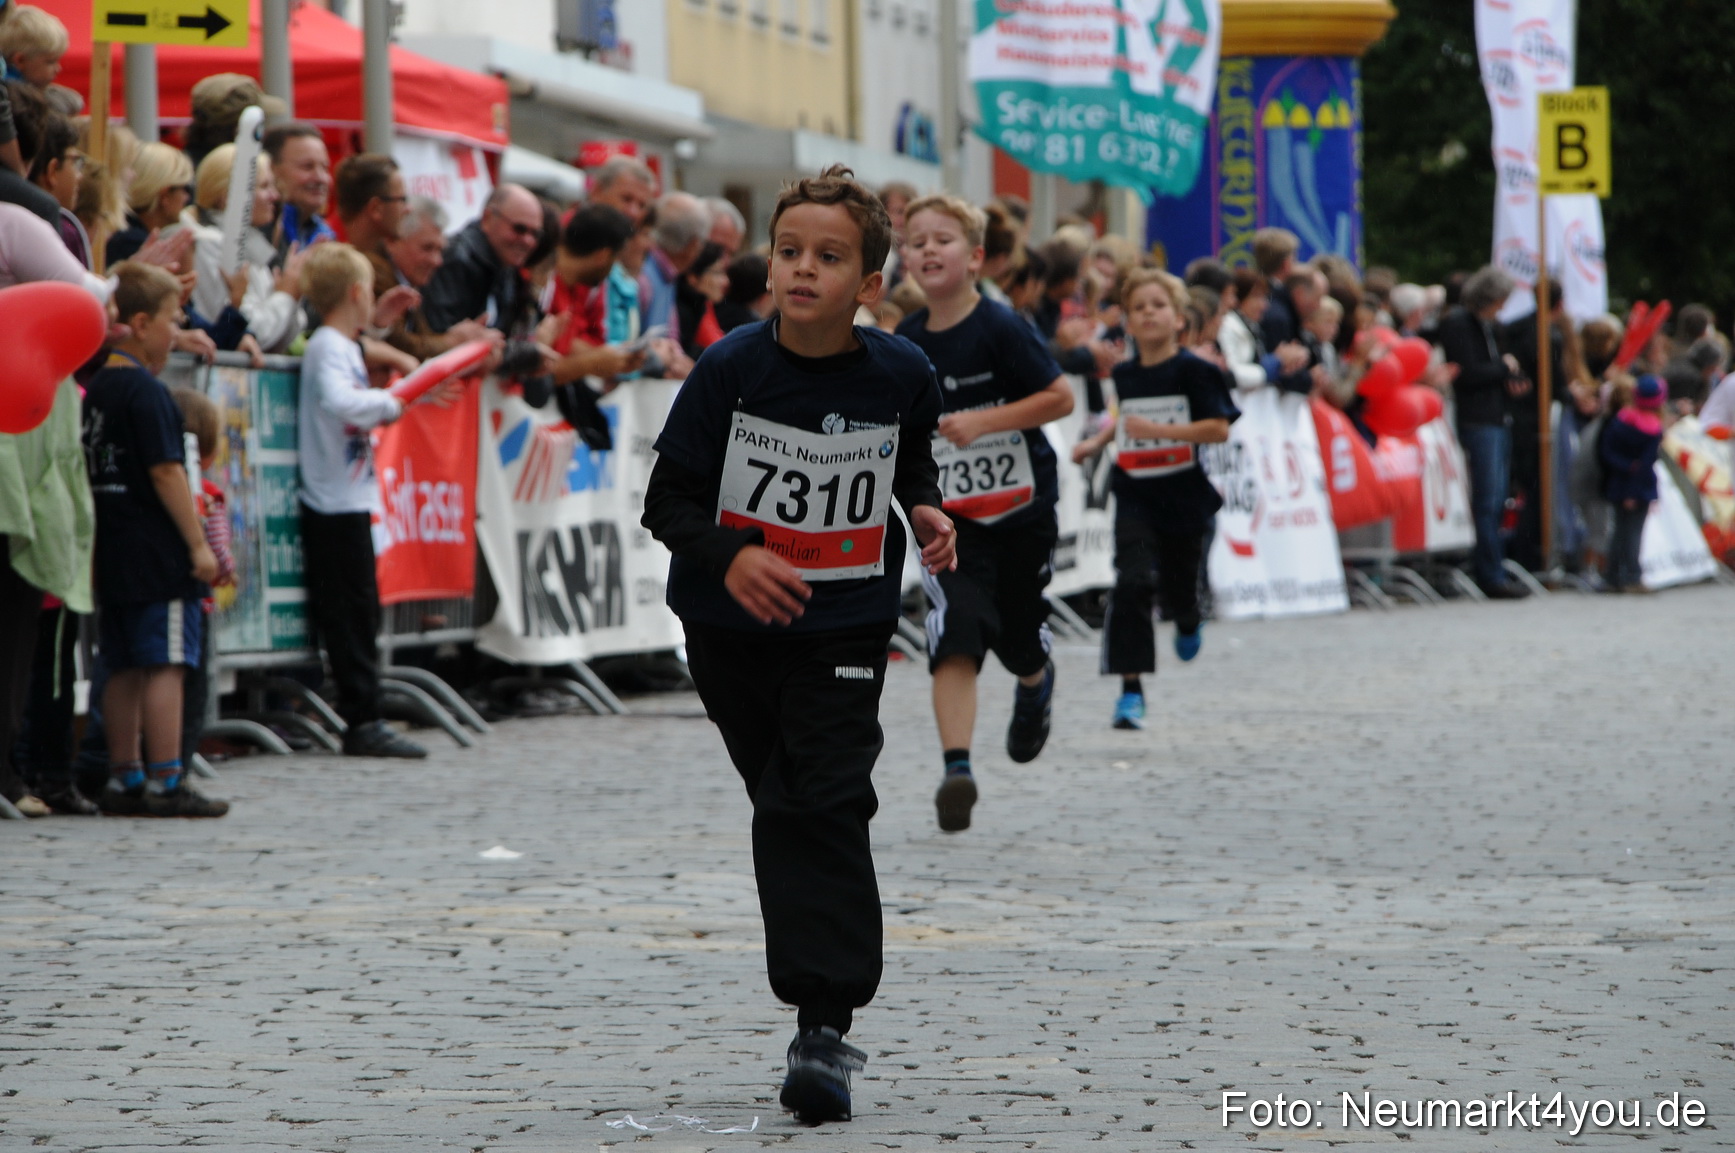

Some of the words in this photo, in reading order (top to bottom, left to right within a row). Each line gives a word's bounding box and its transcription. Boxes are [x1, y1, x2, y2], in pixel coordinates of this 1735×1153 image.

[1543, 93, 1599, 112] Block
[1557, 123, 1589, 170] B
[734, 427, 792, 457] PARTL
[796, 446, 873, 465] Neumarkt
[746, 457, 876, 528] 7310
[938, 453, 1018, 497] 7332
[764, 534, 821, 561] imilian
[835, 666, 864, 679] PUMA
